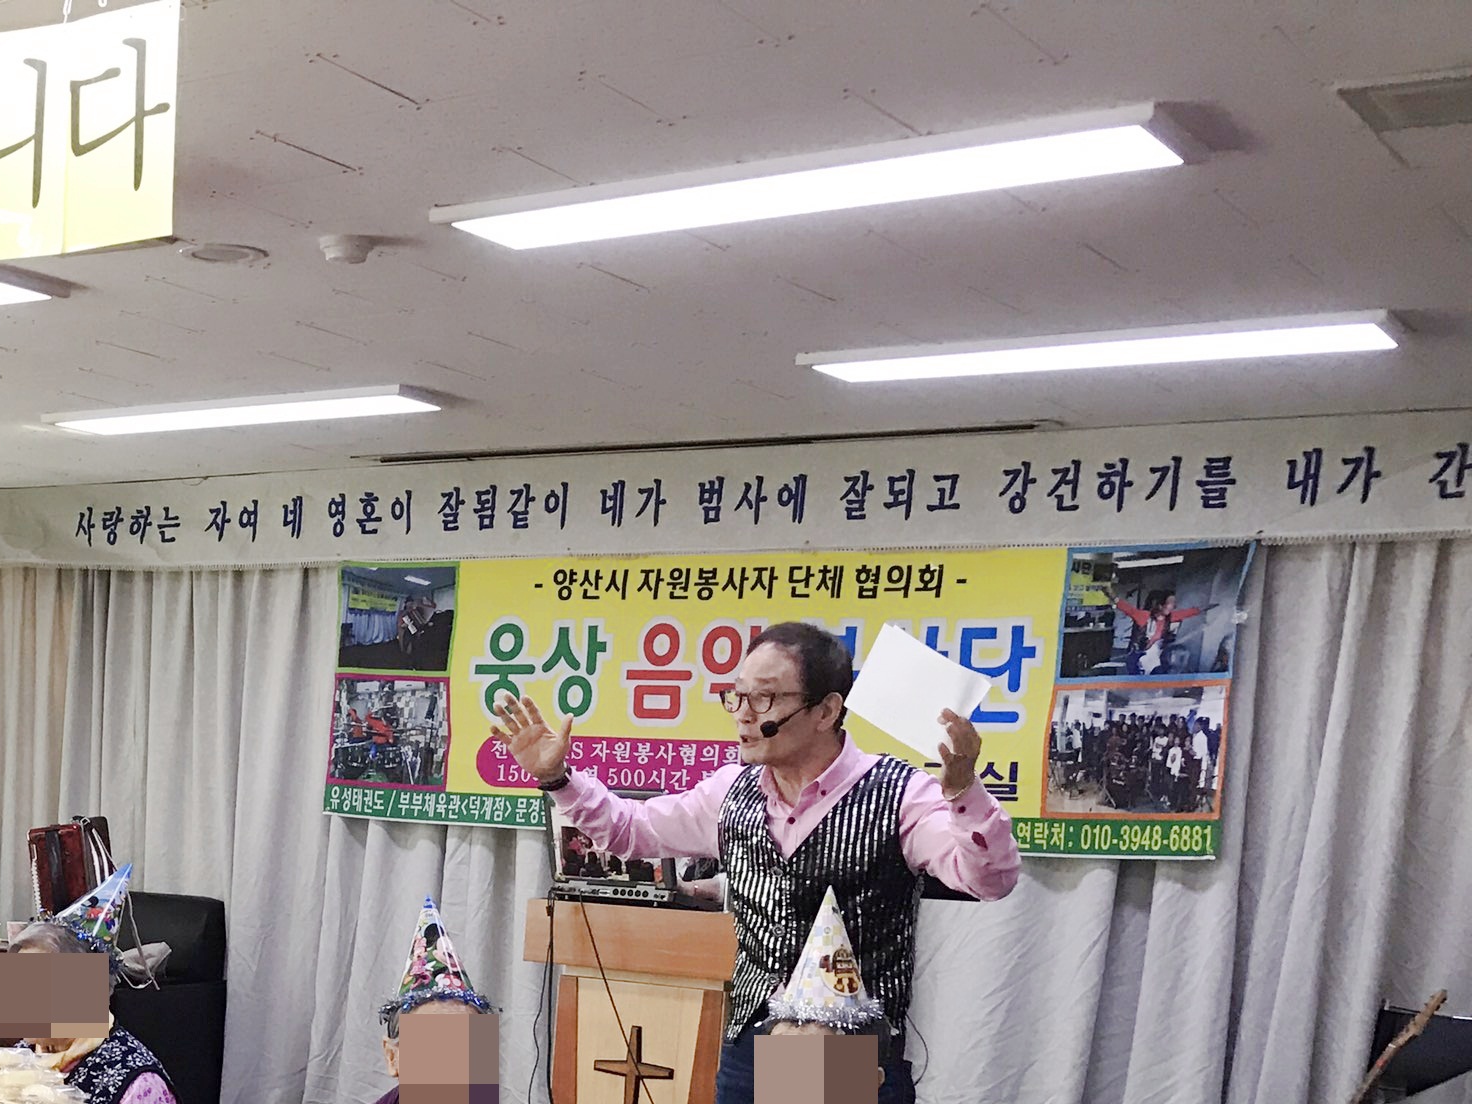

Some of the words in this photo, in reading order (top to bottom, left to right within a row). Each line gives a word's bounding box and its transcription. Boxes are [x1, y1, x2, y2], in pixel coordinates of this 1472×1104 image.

[76, 505, 181, 547] 사랑하는
[204, 499, 260, 543] 자여
[282, 495, 304, 539] 네
[328, 489, 413, 538] 영혼이
[437, 481, 570, 532] 잘됨같이
[600, 478, 667, 528] 네가
[698, 473, 809, 526] 범사에
[840, 468, 961, 521] 잘되고
[999, 456, 1237, 515] 강건하기를
[1286, 446, 1382, 507] 내가
[553, 567, 629, 602] 양산시
[637, 564, 779, 600] 자원봉사자
[787, 564, 843, 598] 단체
[855, 563, 945, 599] 협의회
[474, 622, 607, 718] 웅상
[590, 740, 742, 767] 자원봉사협의회
[607, 768, 691, 791] 500시간
[329, 786, 385, 812] 유성태권도
[1080, 824, 1214, 853] 010-3948-6881
